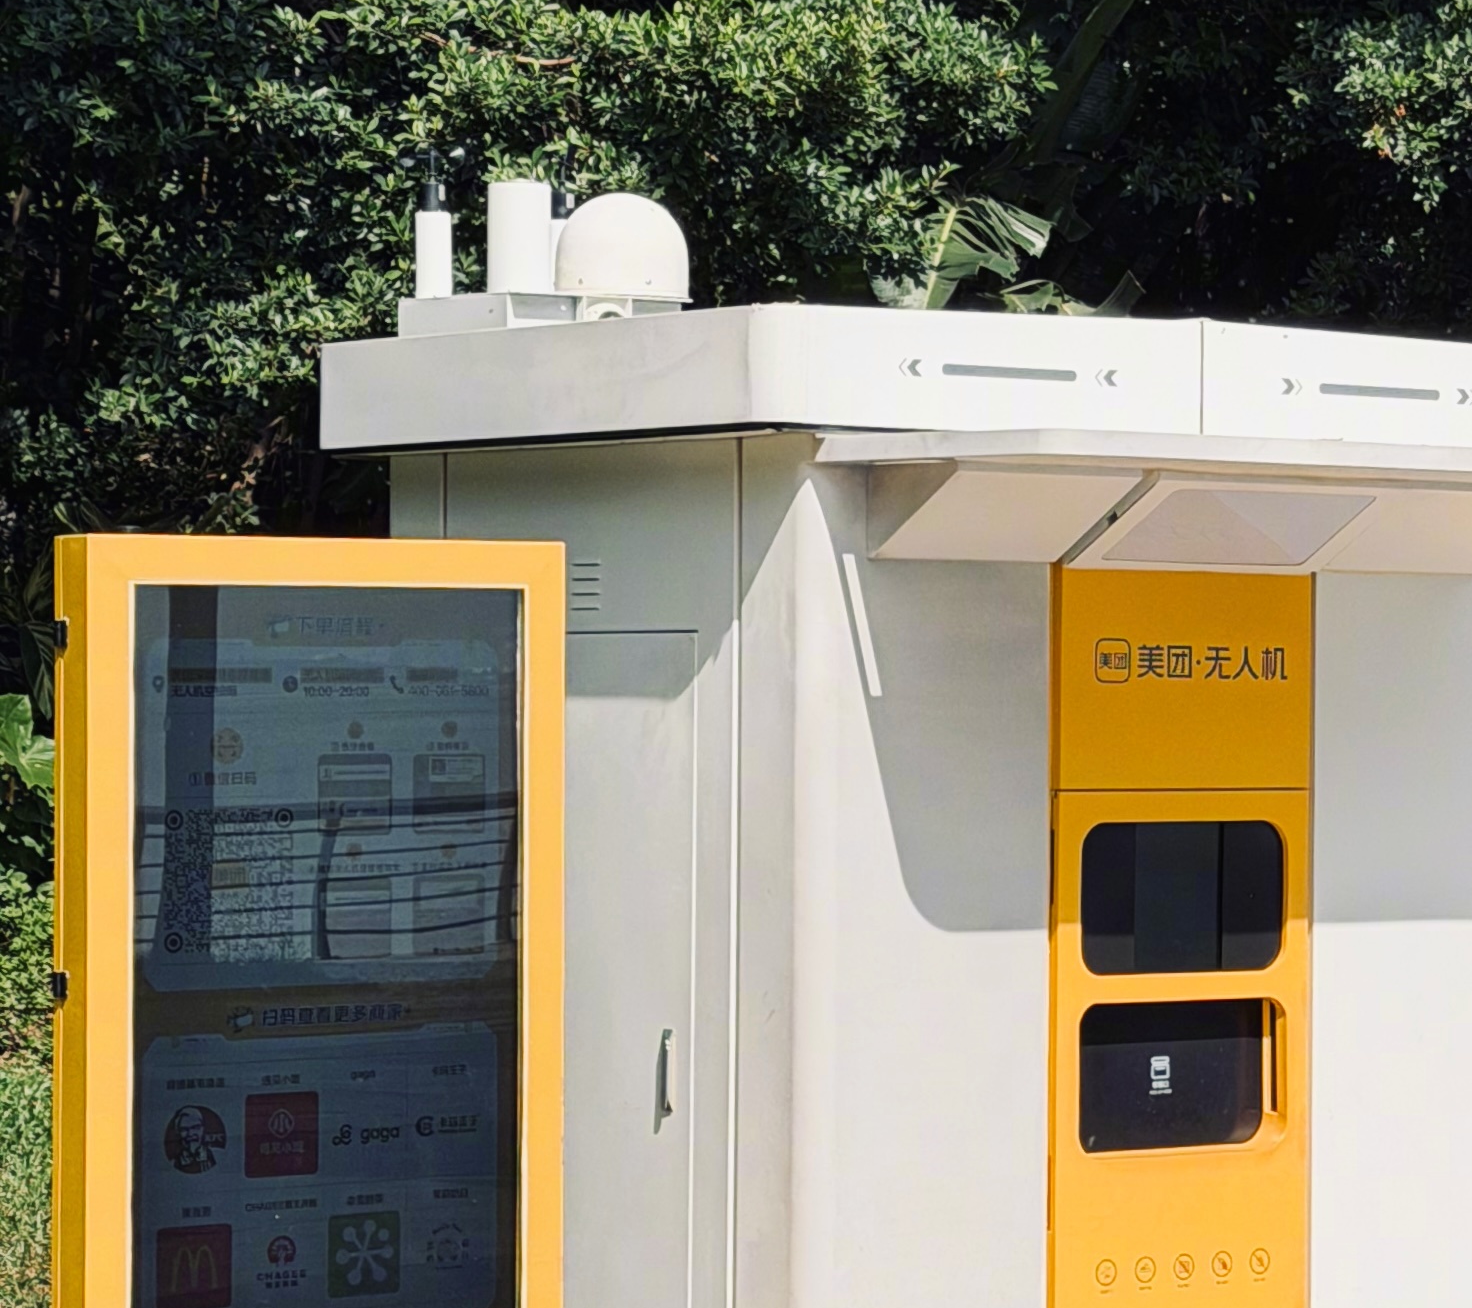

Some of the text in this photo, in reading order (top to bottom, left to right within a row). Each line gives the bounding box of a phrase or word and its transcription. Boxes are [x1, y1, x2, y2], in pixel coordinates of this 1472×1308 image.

[1099, 653, 1127, 670] 美团
[1137, 644, 1288, 680] 美团·无人机
[360, 1124, 400, 1145] gaga
